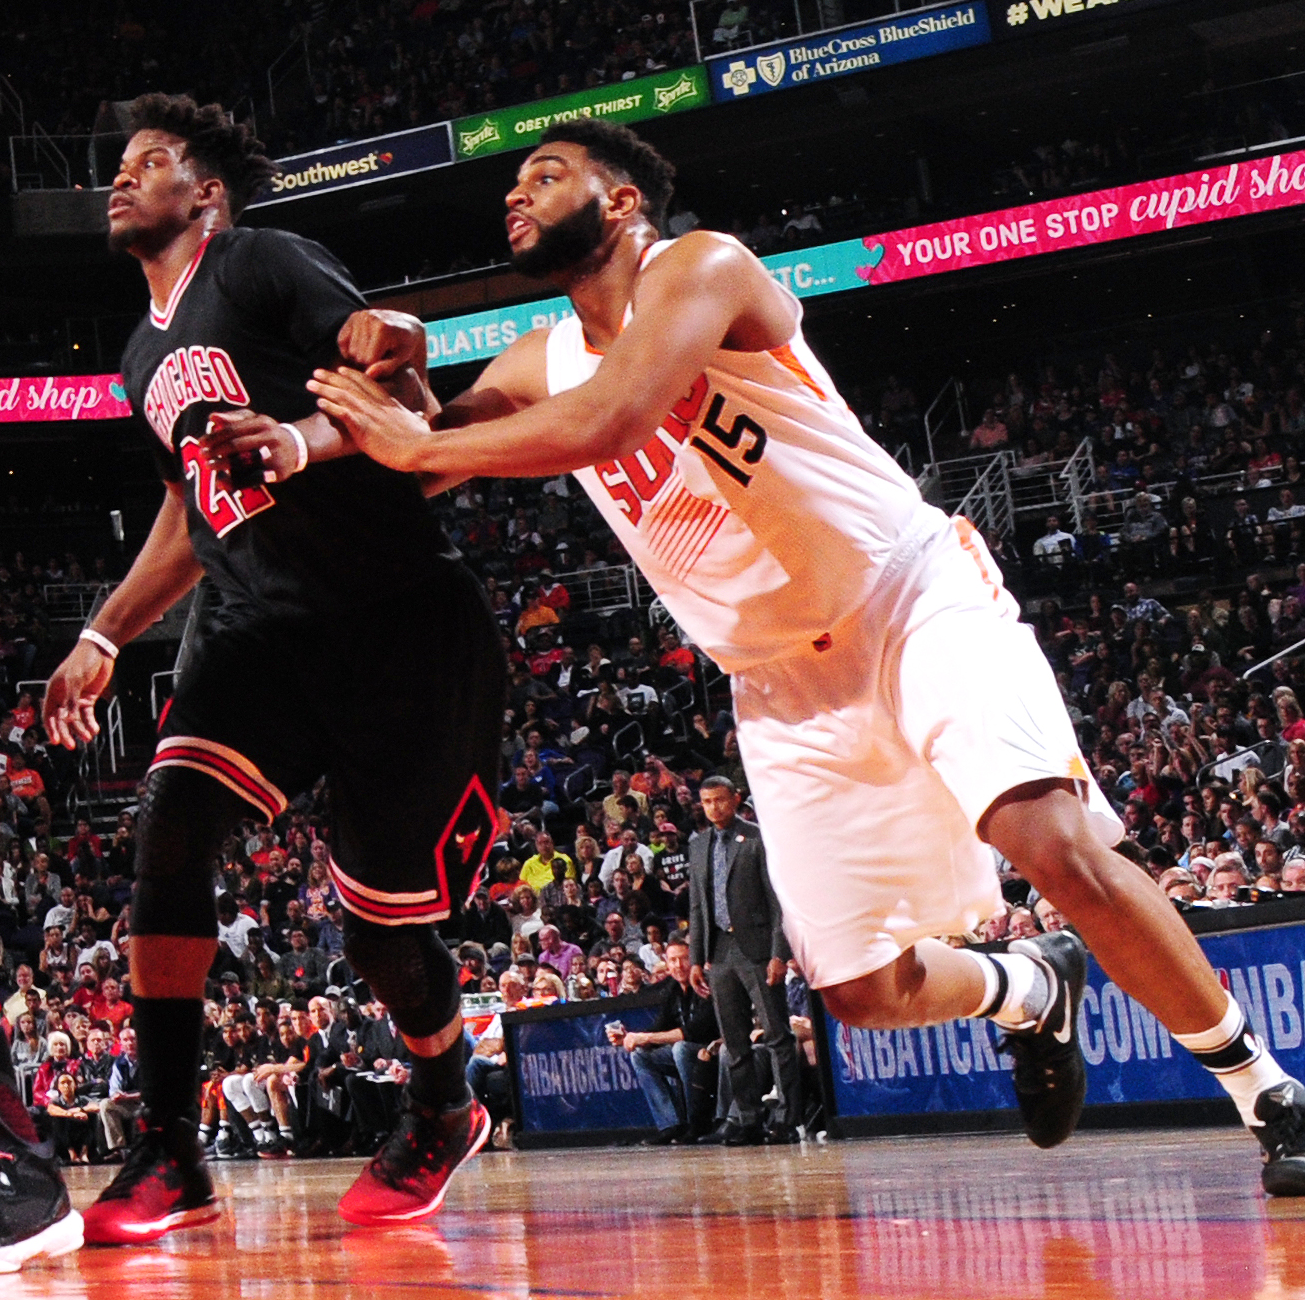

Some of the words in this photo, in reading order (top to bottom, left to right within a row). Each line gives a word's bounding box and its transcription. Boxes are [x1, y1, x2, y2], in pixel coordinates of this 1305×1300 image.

[789, 35, 876, 65] BlueCross
[878, 8, 976, 45] BlueShield
[791, 63, 811, 82] of
[813, 52, 881, 77] Arizona
[514, 115, 552, 134] OBEY
[593, 95, 643, 116] THIRST
[272, 151, 379, 192] Southwest
[896, 231, 972, 267] YOUR
[979, 216, 1037, 252] ONE
[1045, 202, 1119, 239] STOP
[1129, 164, 1240, 229] cupid
[26, 376, 103, 420] shop
[691, 392, 767, 488] 15
